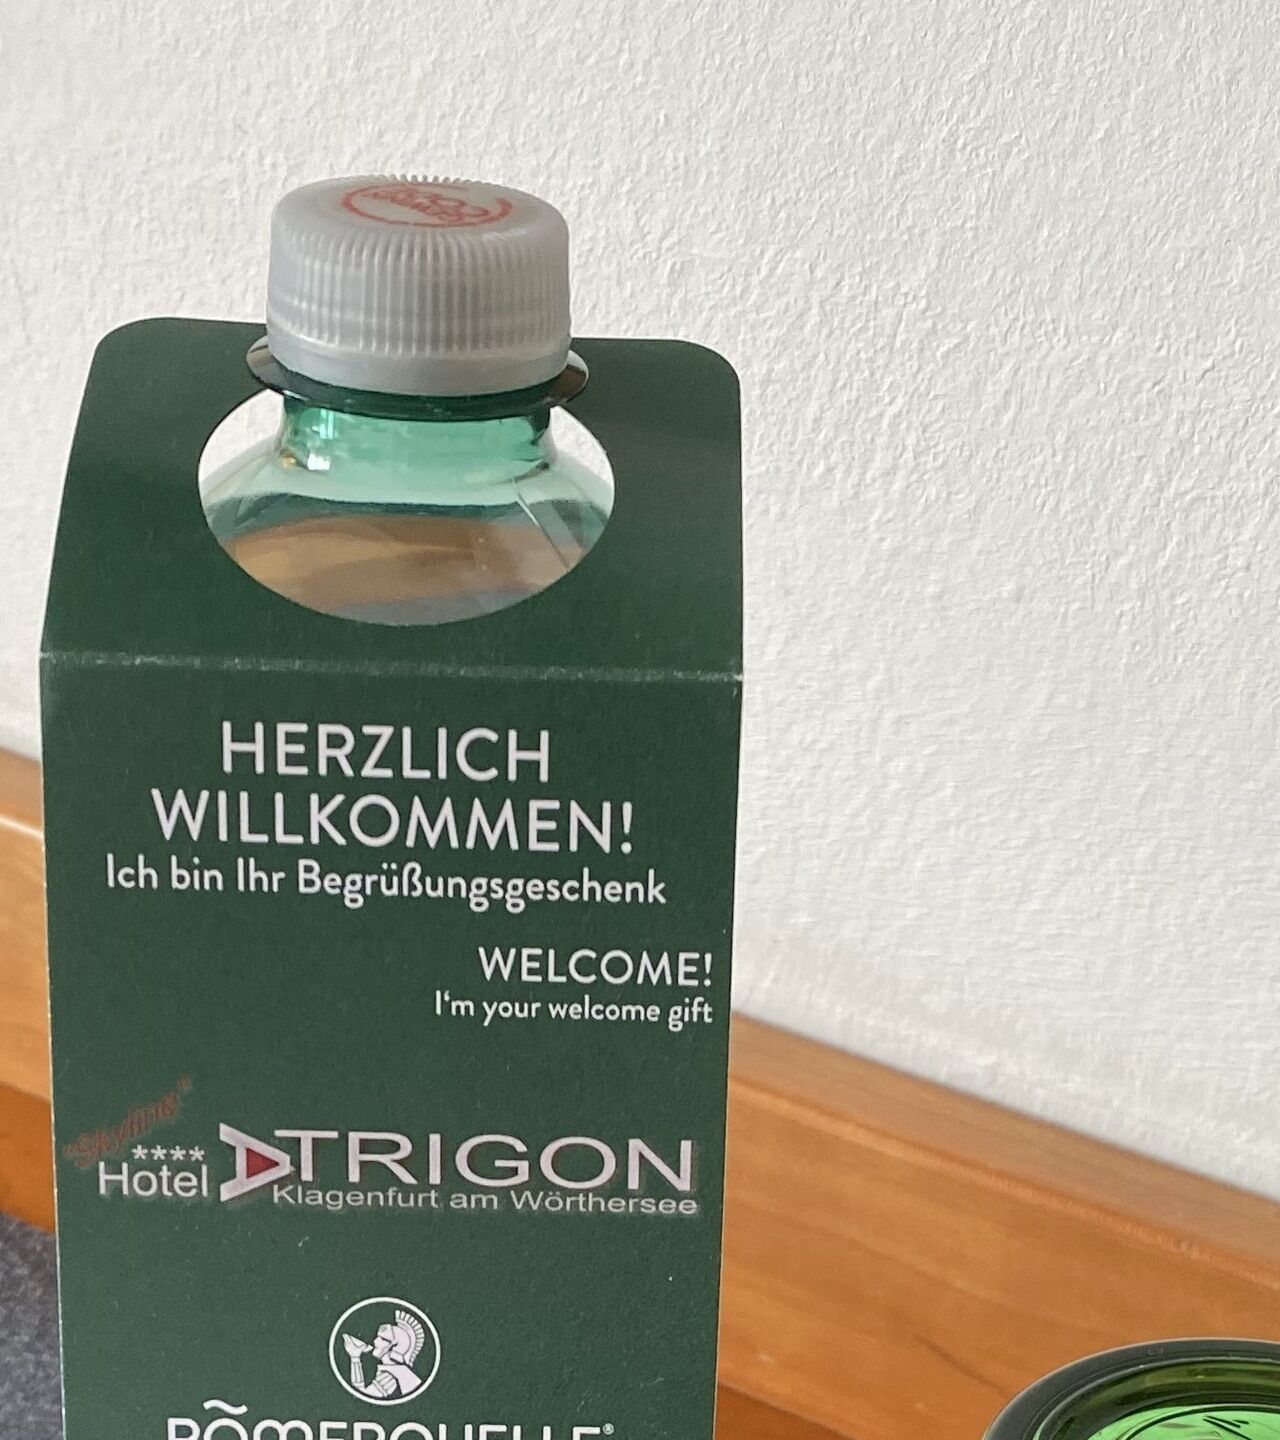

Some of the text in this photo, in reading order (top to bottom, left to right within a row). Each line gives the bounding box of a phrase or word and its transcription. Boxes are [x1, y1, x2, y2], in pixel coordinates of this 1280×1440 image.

[221, 721, 551, 783] HERZLICH
[150, 788, 634, 853] WILLKOMMEN!
[106, 854, 667, 914] Ich bin Ihr Begrüßungsgeschenk
[478, 946, 714, 988] WELCOME!
[435, 989, 713, 1032] I'm your welcome gift
[98, 1161, 208, 1198] Hotel
[273, 1184, 698, 1216] Klagenfurt am Wörthersee
